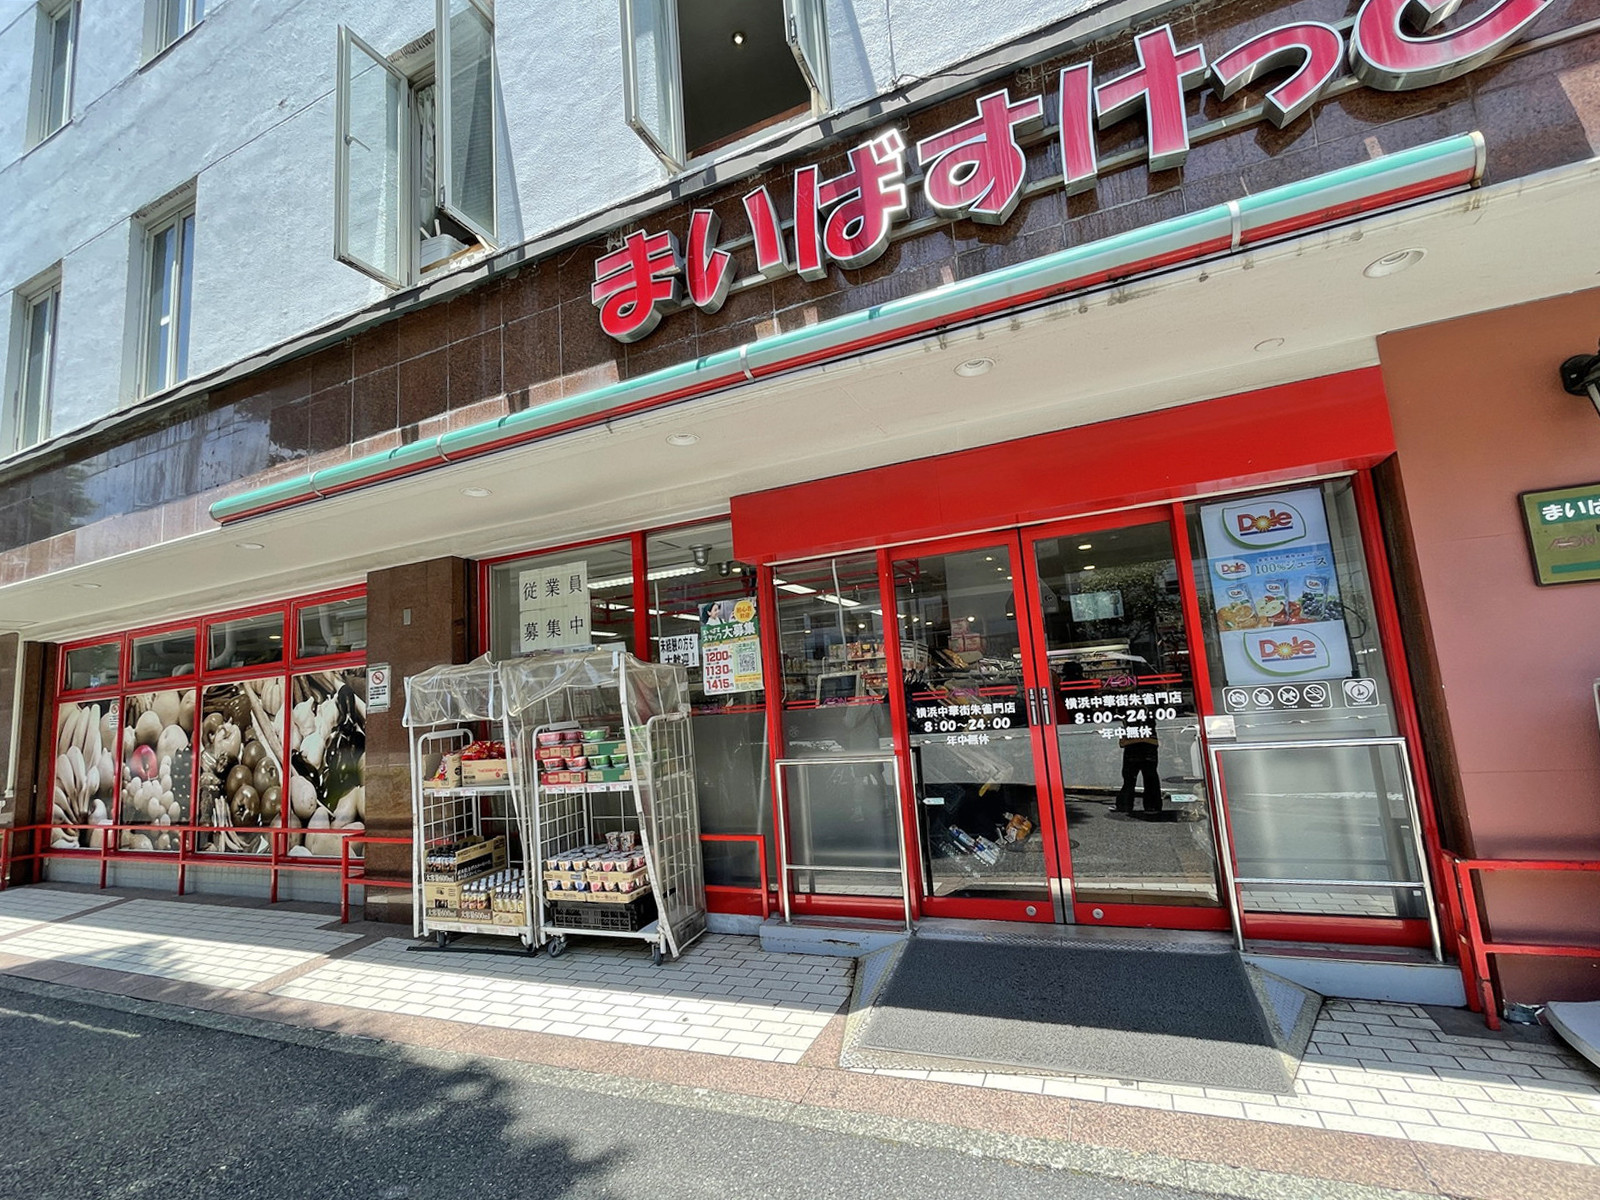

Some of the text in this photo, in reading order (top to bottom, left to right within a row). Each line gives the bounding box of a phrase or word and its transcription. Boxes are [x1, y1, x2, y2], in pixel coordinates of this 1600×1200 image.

[1237, 509, 1293, 532] Dole
[1221, 562, 1246, 574] Dole
[523, 574, 582, 601] 従業員
[524, 616, 584, 641] 募集中
[722, 622, 756, 639] 大募集
[660, 636, 695, 653] 未経験の方も
[1259, 636, 1316, 659] Dole
[1065, 691, 1182, 710] 横浜中華街朱雀門店
[916, 702, 1016, 718] 横浜中華街朱雀門店
[1074, 708, 1177, 725] 8:00～24:00
[924, 717, 1011, 733] 8:00～24:00
[1101, 725, 1152, 739] 年中無休
[947, 734, 990, 746] 年中無休
